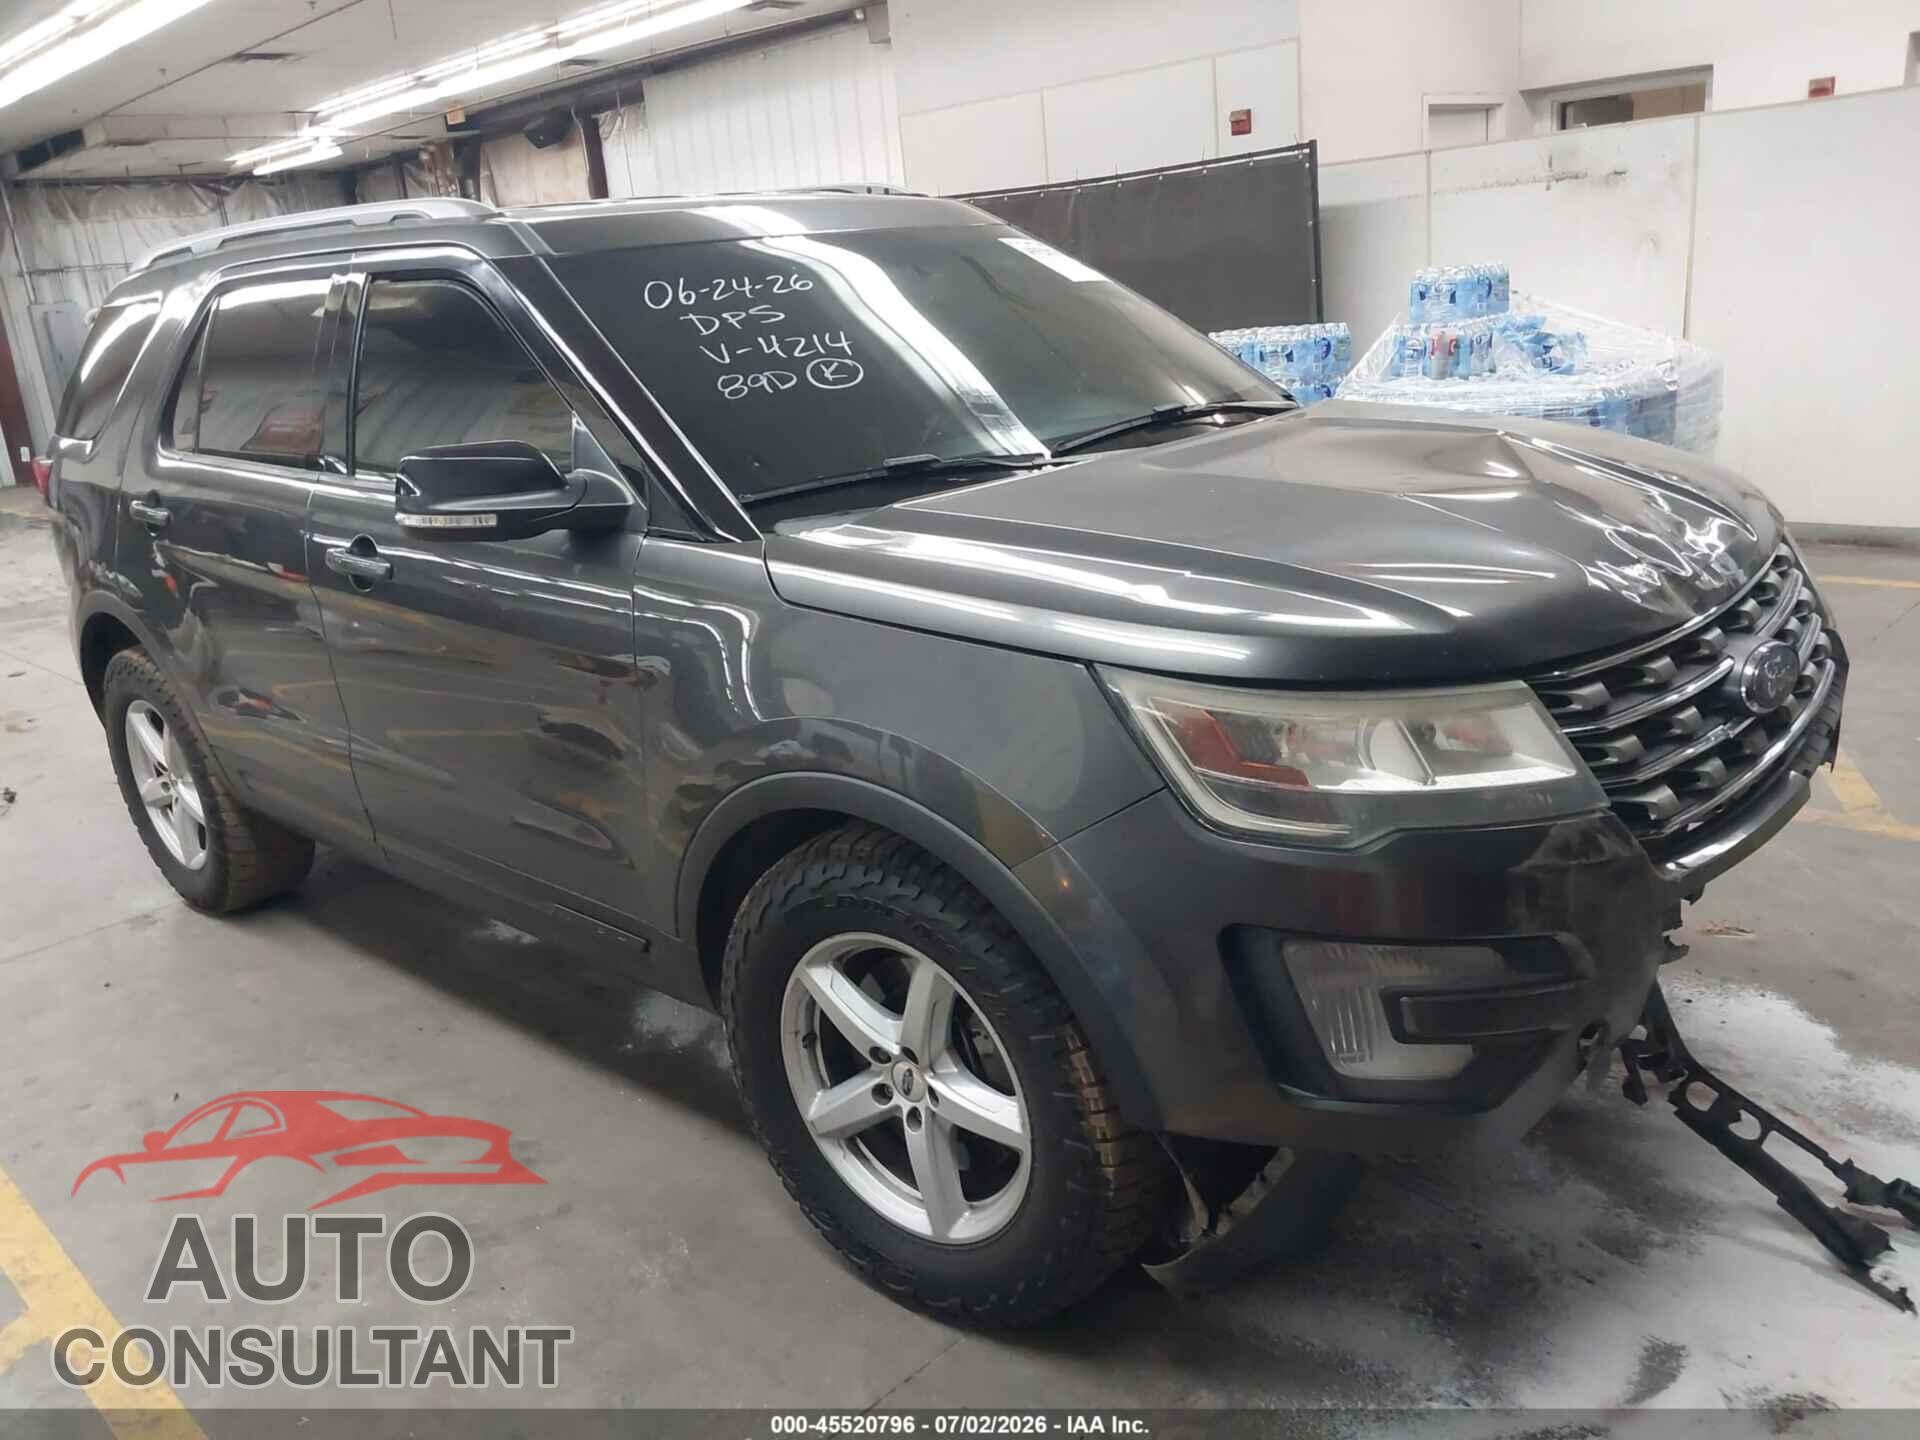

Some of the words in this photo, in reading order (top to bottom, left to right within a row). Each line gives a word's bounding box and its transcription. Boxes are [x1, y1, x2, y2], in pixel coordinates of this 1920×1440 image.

[643, 273, 814, 310] 06-24-26
[679, 304, 786, 336] DPS
[699, 330, 853, 364] V-4214
